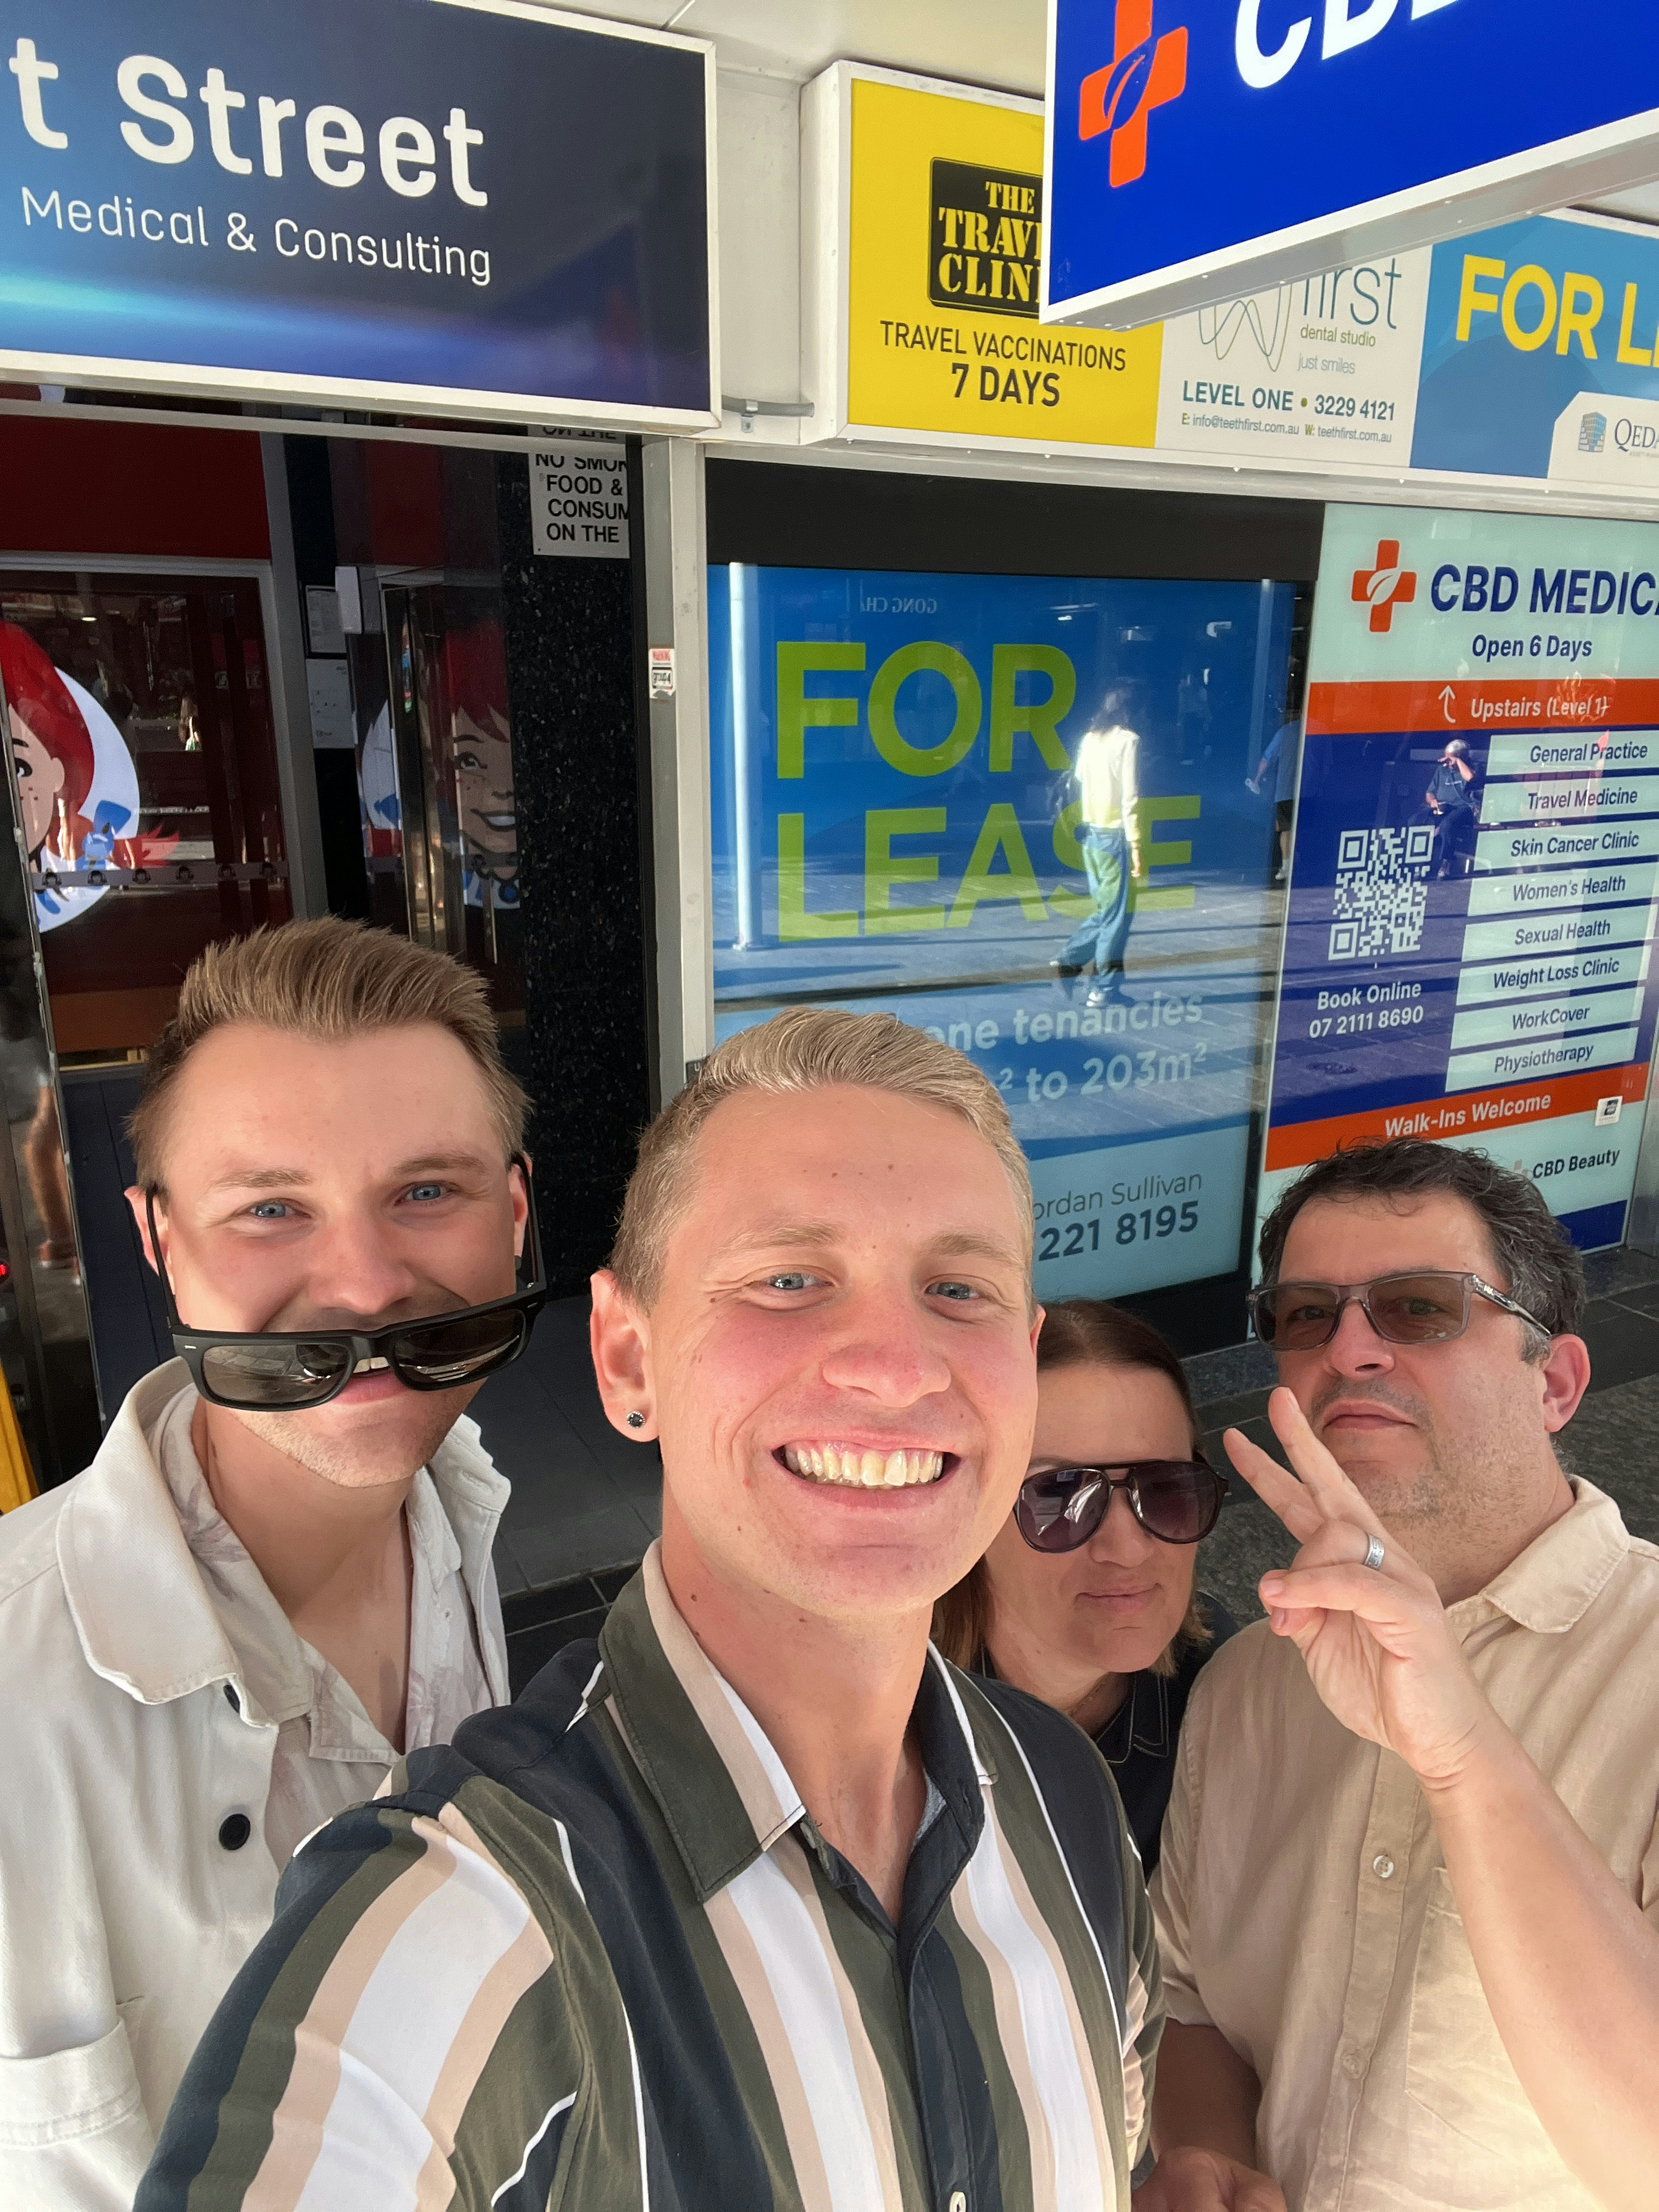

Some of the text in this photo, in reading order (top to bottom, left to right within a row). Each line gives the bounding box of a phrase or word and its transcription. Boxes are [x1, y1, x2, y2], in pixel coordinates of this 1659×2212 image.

[9, 38, 488, 206] t Street
[985, 182, 1035, 214] THE
[21, 187, 490, 286] Medical & Consulting
[1456, 254, 1659, 368] FOR L
[881, 320, 1126, 371] TRAVEL VACCINATIONS
[1300, 324, 1376, 347] dental studio
[1297, 353, 1355, 374] just smiles
[951, 363, 1060, 407] 7 DAYS
[1183, 381, 1395, 421] LEVEL ONE 3229 4121
[1193, 414, 1299, 435] info@teethfirst.com.au
[1318, 427, 1392, 443] teethfirst.com.au
[546, 475, 623, 495] FOOD &
[549, 499, 628, 520] CONSUM
[547, 523, 619, 543] ON THE
[1431, 564, 1659, 616] CBD MEDIC
[1472, 635, 1592, 662] Open 6 Days
[777, 641, 1076, 778] FOR
[1471, 697, 1541, 723] Upstairs
[1547, 697, 1591, 717] (Level
[1530, 742, 1647, 763] General Practice
[1528, 787, 1638, 810] Travel Medicine
[1510, 831, 1640, 857] Skin Cancer Clinic
[1513, 876, 1626, 902] Women's Health
[1515, 919, 1610, 945] Sexual Health
[1494, 957, 1620, 989] Weight Loss Clinic
[1317, 981, 1421, 1010] Book Online
[1014, 991, 1202, 1045] tenancies
[1309, 1005, 1424, 1038] 07 2111 8690
[1513, 1007, 1590, 1030] WorkCover
[1494, 1045, 1594, 1074] Physiotherapy
[1026, 1068, 1068, 1102] to
[1385, 1094, 1551, 1138] Walk-Ins Welcome
[1533, 1149, 1620, 1179] CBD Beauty
[1111, 1173, 1201, 1205] Sullivan
[1039, 1200, 1199, 1261] 221 8195
